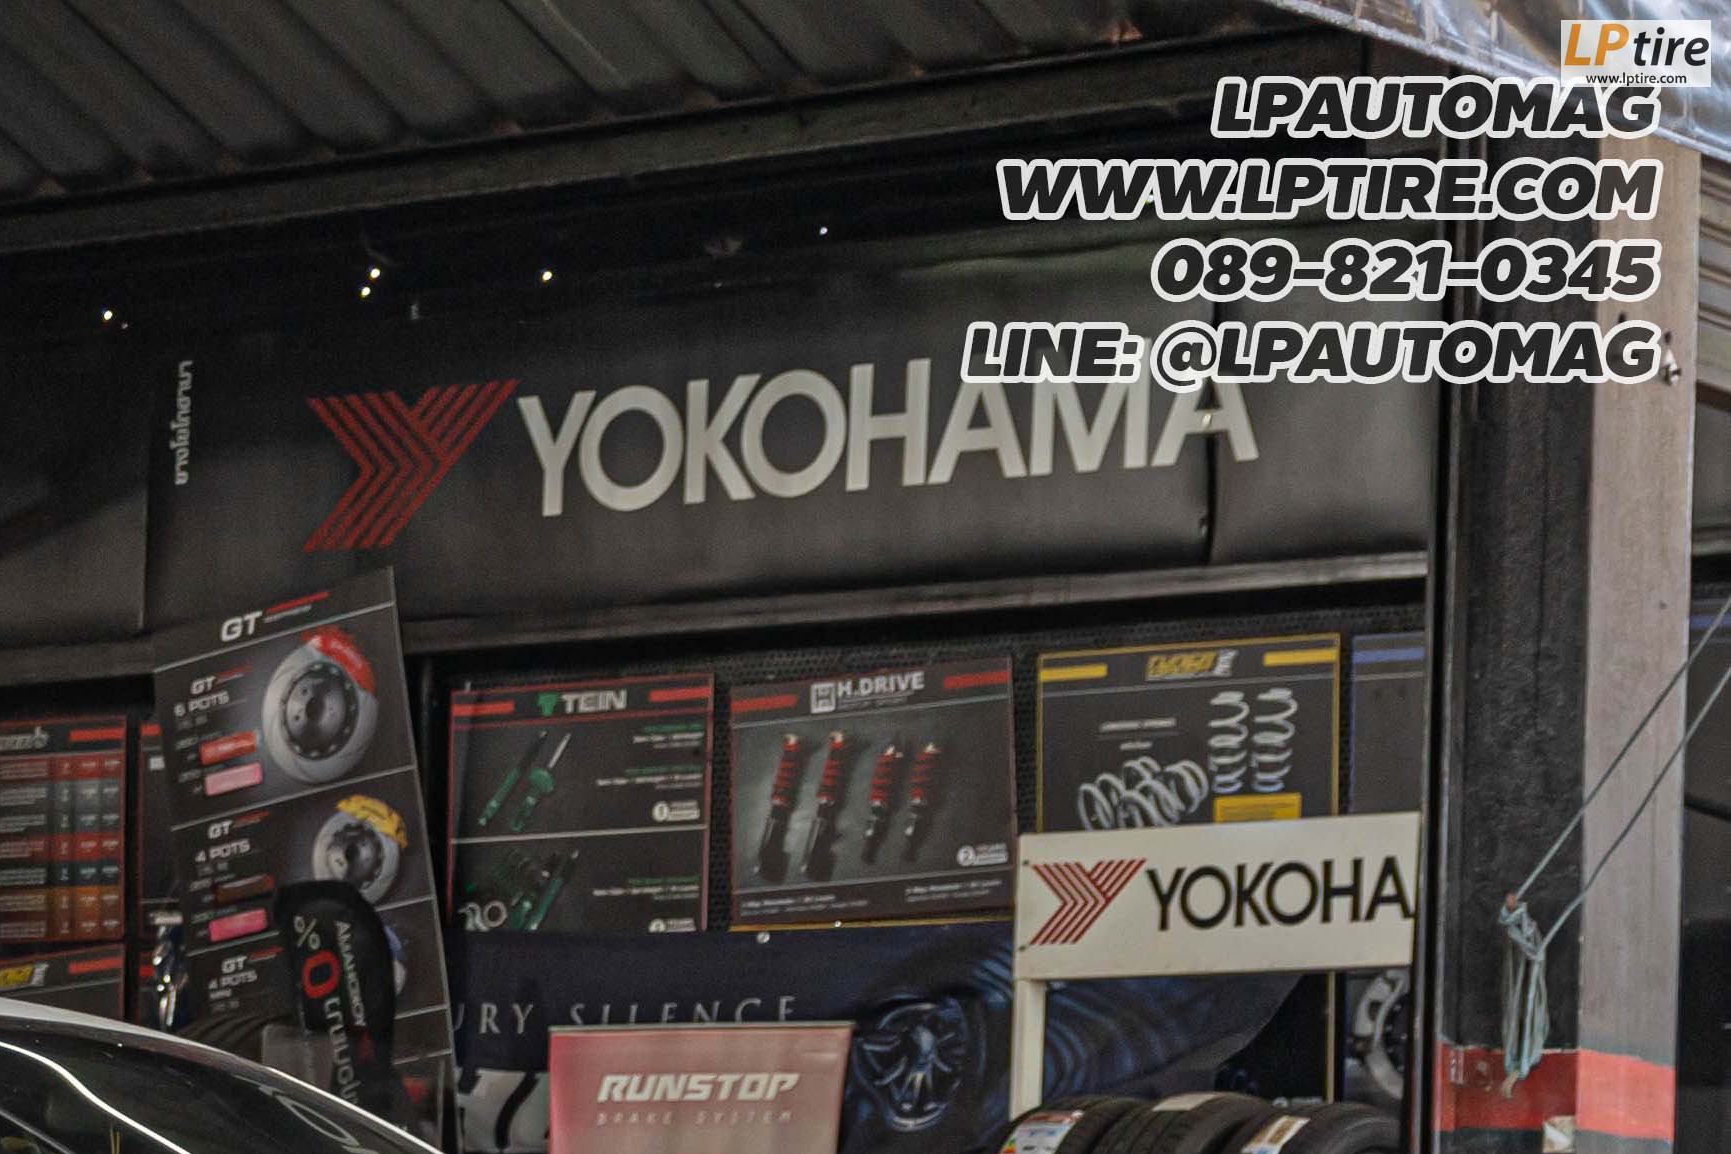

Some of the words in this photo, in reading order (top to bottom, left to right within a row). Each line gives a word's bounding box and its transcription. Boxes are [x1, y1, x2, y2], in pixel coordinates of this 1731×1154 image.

[517, 340, 1258, 516] YOKOHAMA
[220, 610, 263, 642] GT
[190, 675, 217, 695] GT
[560, 690, 627, 714] TEIN
[1146, 856, 1414, 932] YOKOHA
[596, 1072, 800, 1104] RUNSTOP
[596, 1110, 675, 1126] BRAKE
[695, 1109, 795, 1125] SYSTEM
